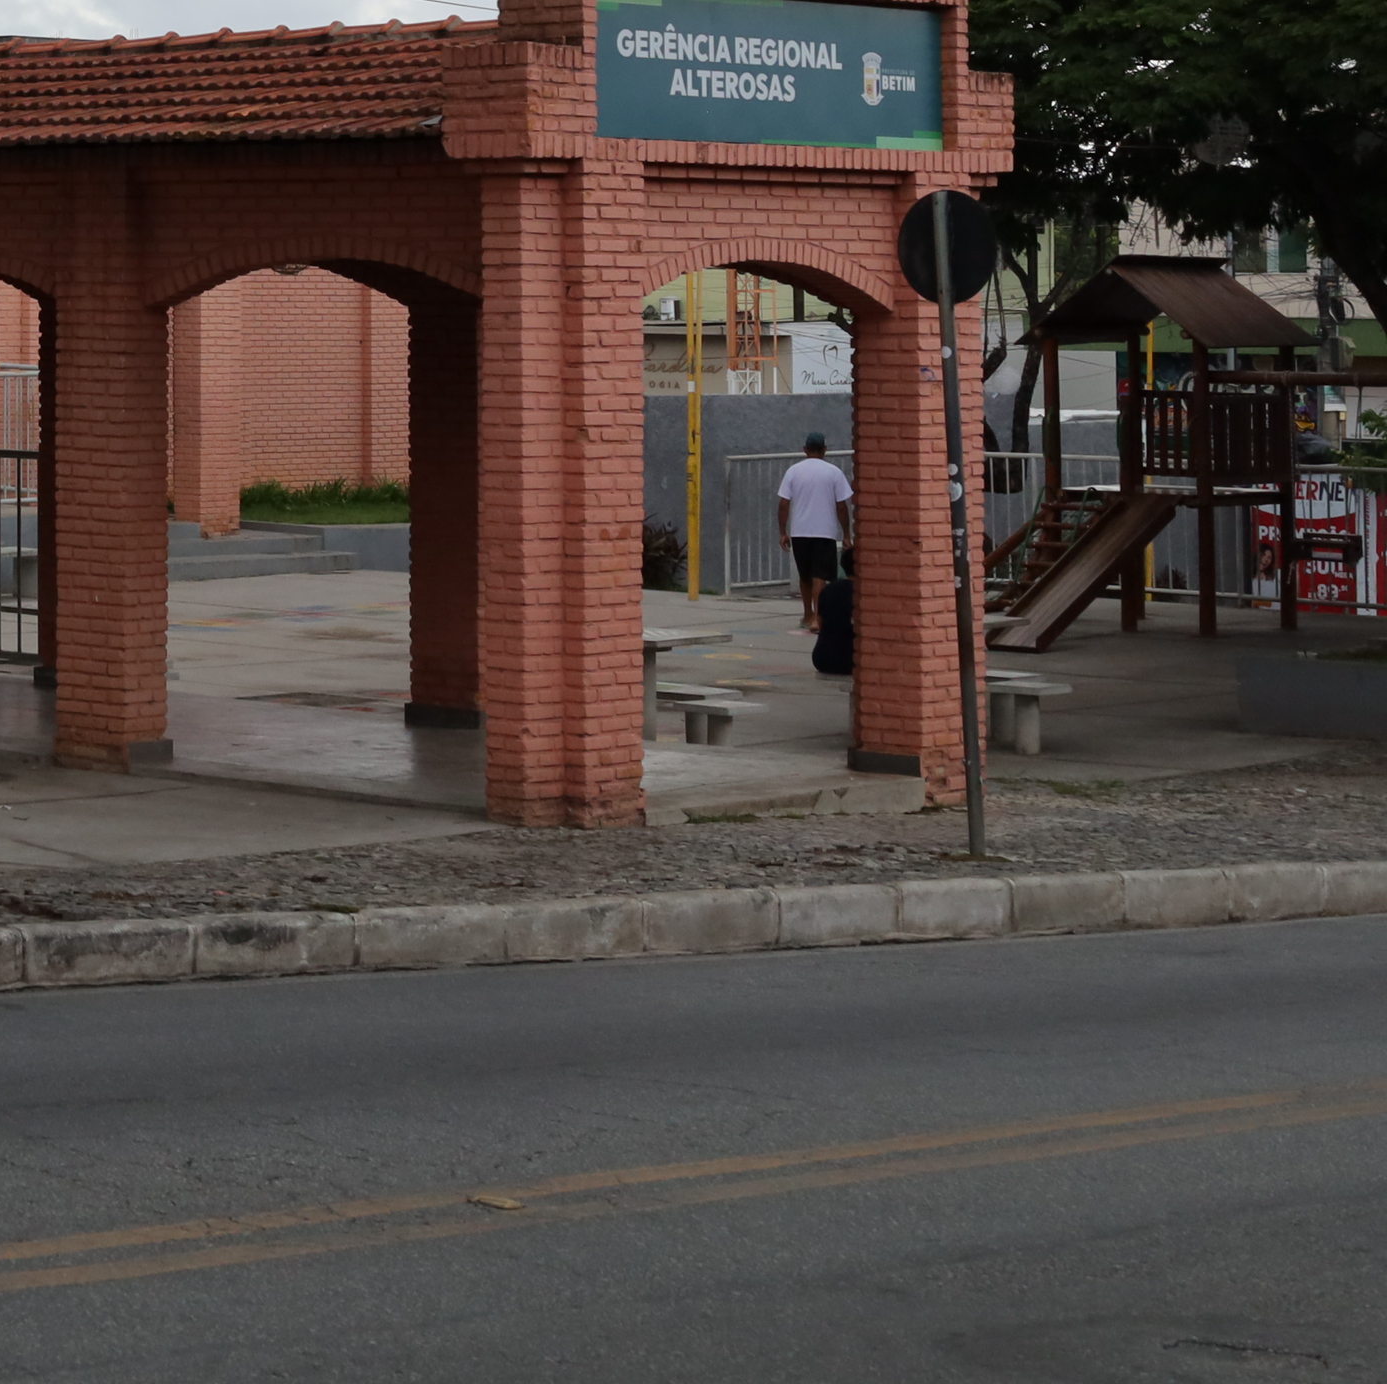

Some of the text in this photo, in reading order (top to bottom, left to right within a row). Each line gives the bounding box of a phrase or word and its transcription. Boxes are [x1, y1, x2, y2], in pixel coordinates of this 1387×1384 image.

[616, 22, 843, 70] GERÊNCIA REGIONAL
[669, 68, 797, 103] ALTEROSAS
[881, 75, 916, 92] BETIM
